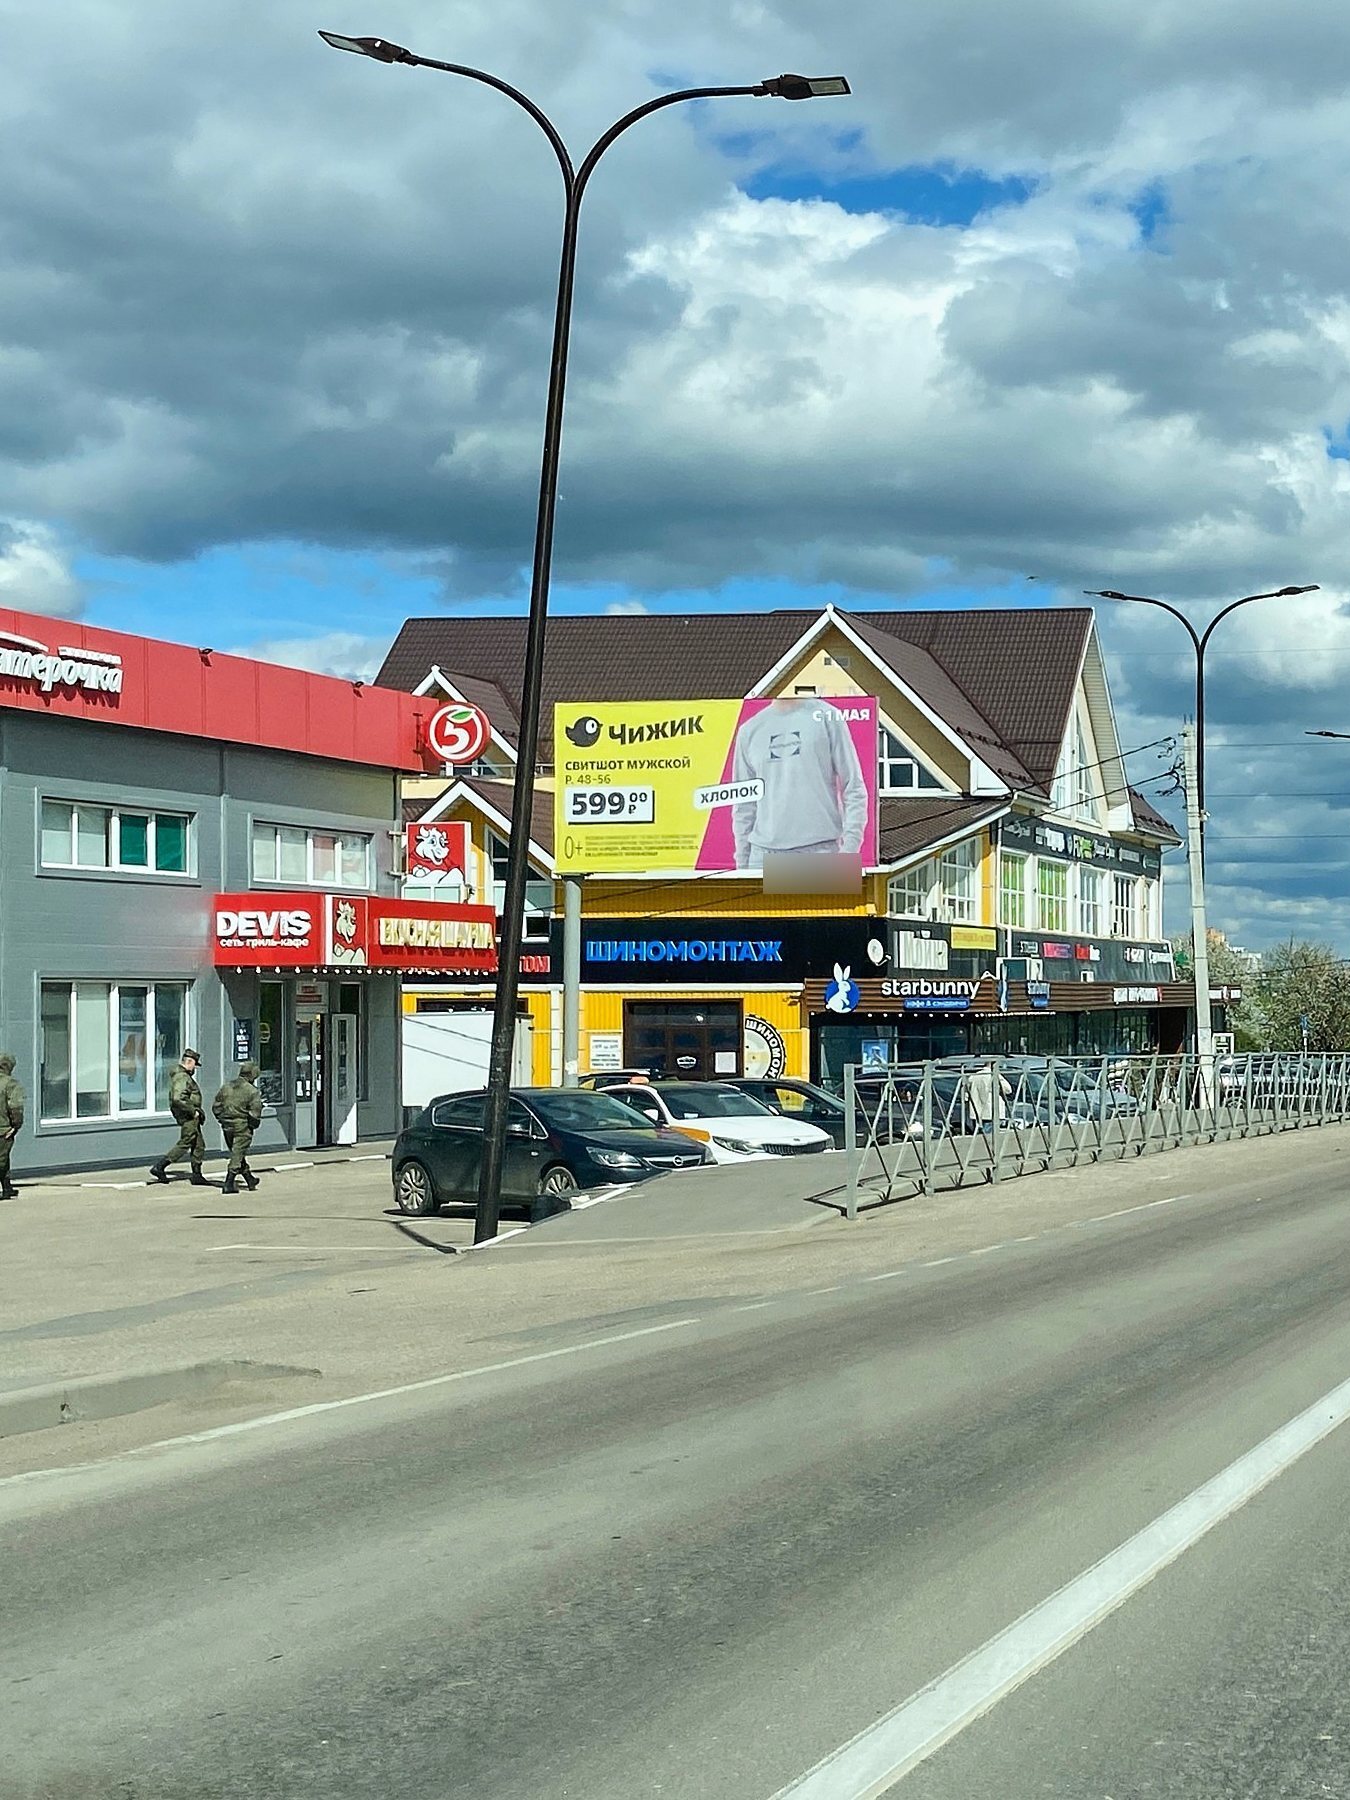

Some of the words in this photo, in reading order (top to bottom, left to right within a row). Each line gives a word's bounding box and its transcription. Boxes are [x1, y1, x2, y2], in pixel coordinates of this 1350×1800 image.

[835, 709, 870, 721] МАЯ
[565, 760, 624, 771] СВИТШОТ
[627, 756, 691, 770] МУЖСКОЙ
[577, 774, 611, 785] 48-56
[572, 792, 625, 815] 599
[700, 784, 759, 804] ХЛОПОК
[216, 910, 312, 937] DEVIS
[220, 939, 244, 948] сеть
[586, 940, 783, 963] ШИНОМОНТАЖ
[881, 978, 981, 999] starbunny
[745, 1018, 781, 1078] ШИНОМОН
